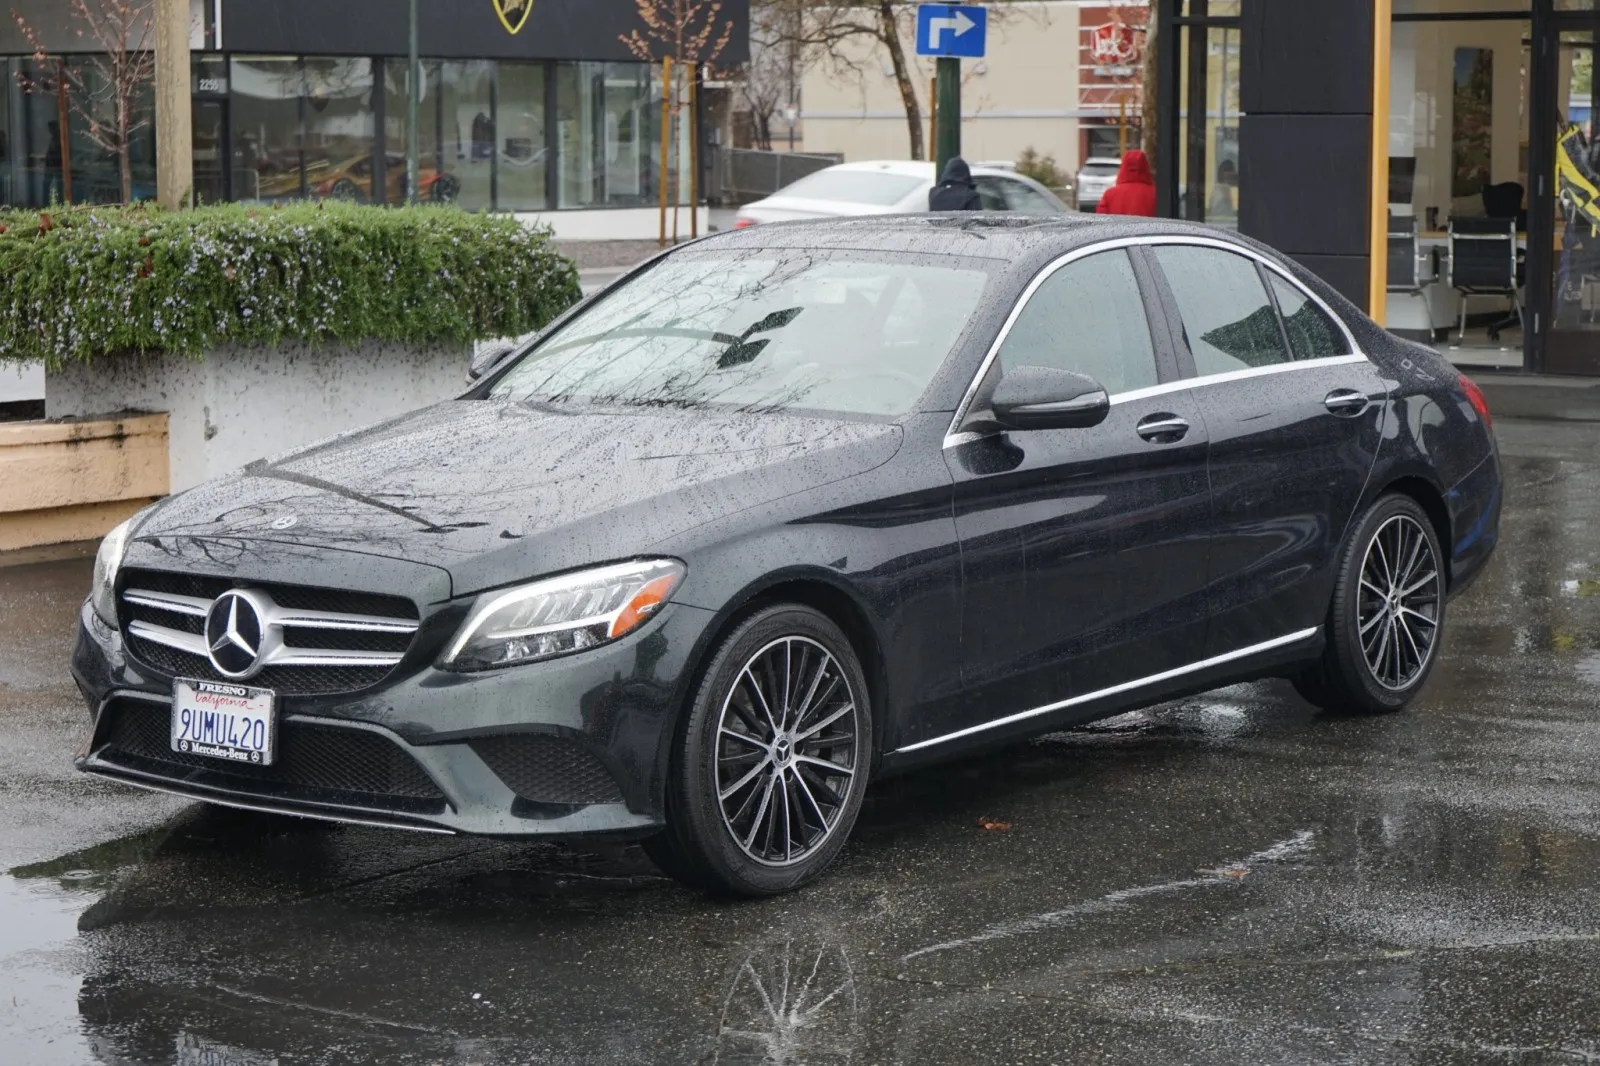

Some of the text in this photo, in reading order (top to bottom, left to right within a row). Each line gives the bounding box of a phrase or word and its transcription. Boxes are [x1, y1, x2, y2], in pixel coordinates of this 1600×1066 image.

[199, 682, 246, 696] FRESNO
[195, 691, 254, 710] California
[180, 708, 265, 750] 9UMU420
[191, 741, 248, 761] Mercedes-Benz
